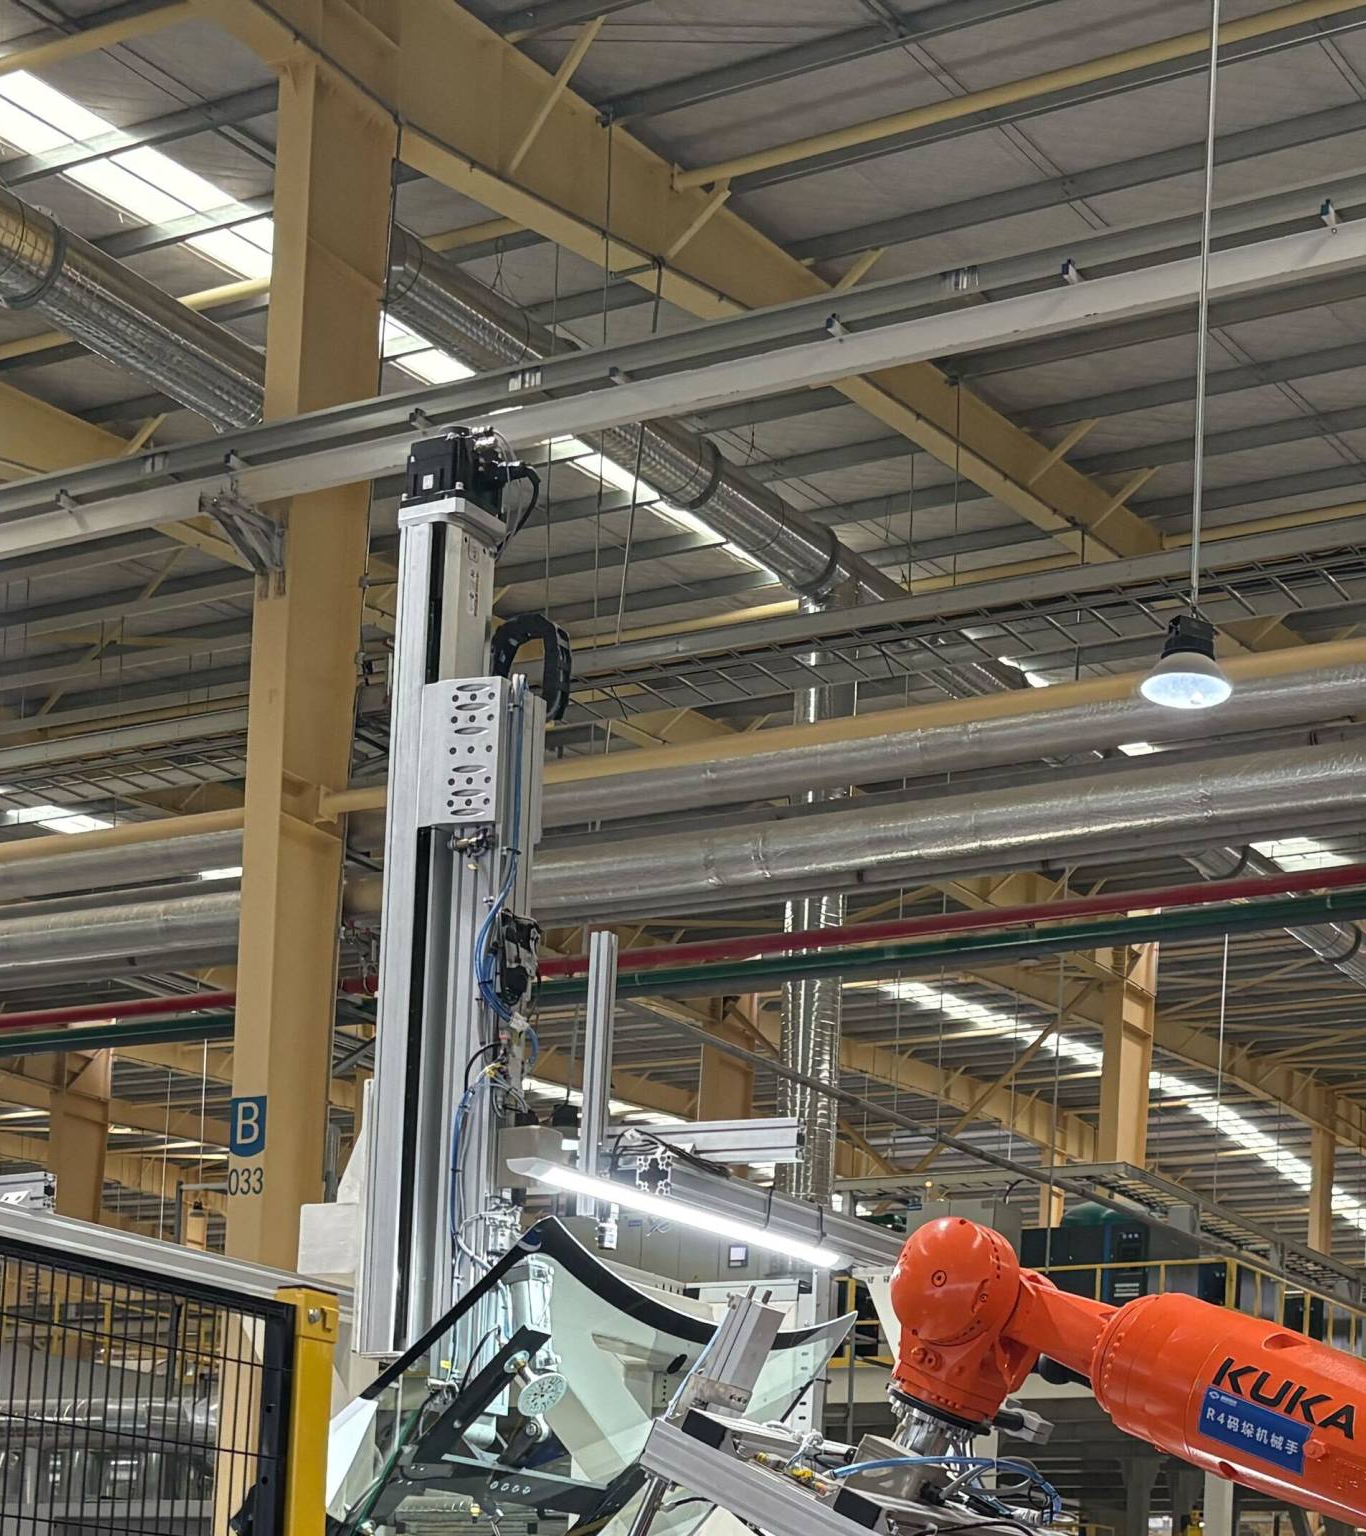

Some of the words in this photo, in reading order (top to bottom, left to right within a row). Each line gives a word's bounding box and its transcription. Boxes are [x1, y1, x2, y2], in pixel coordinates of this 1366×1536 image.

[237, 1102, 259, 1144] B
[229, 1167, 263, 1195] 033
[1212, 1357, 1356, 1440] KUKA
[1206, 1407, 1300, 1455] R4码垛机械手
